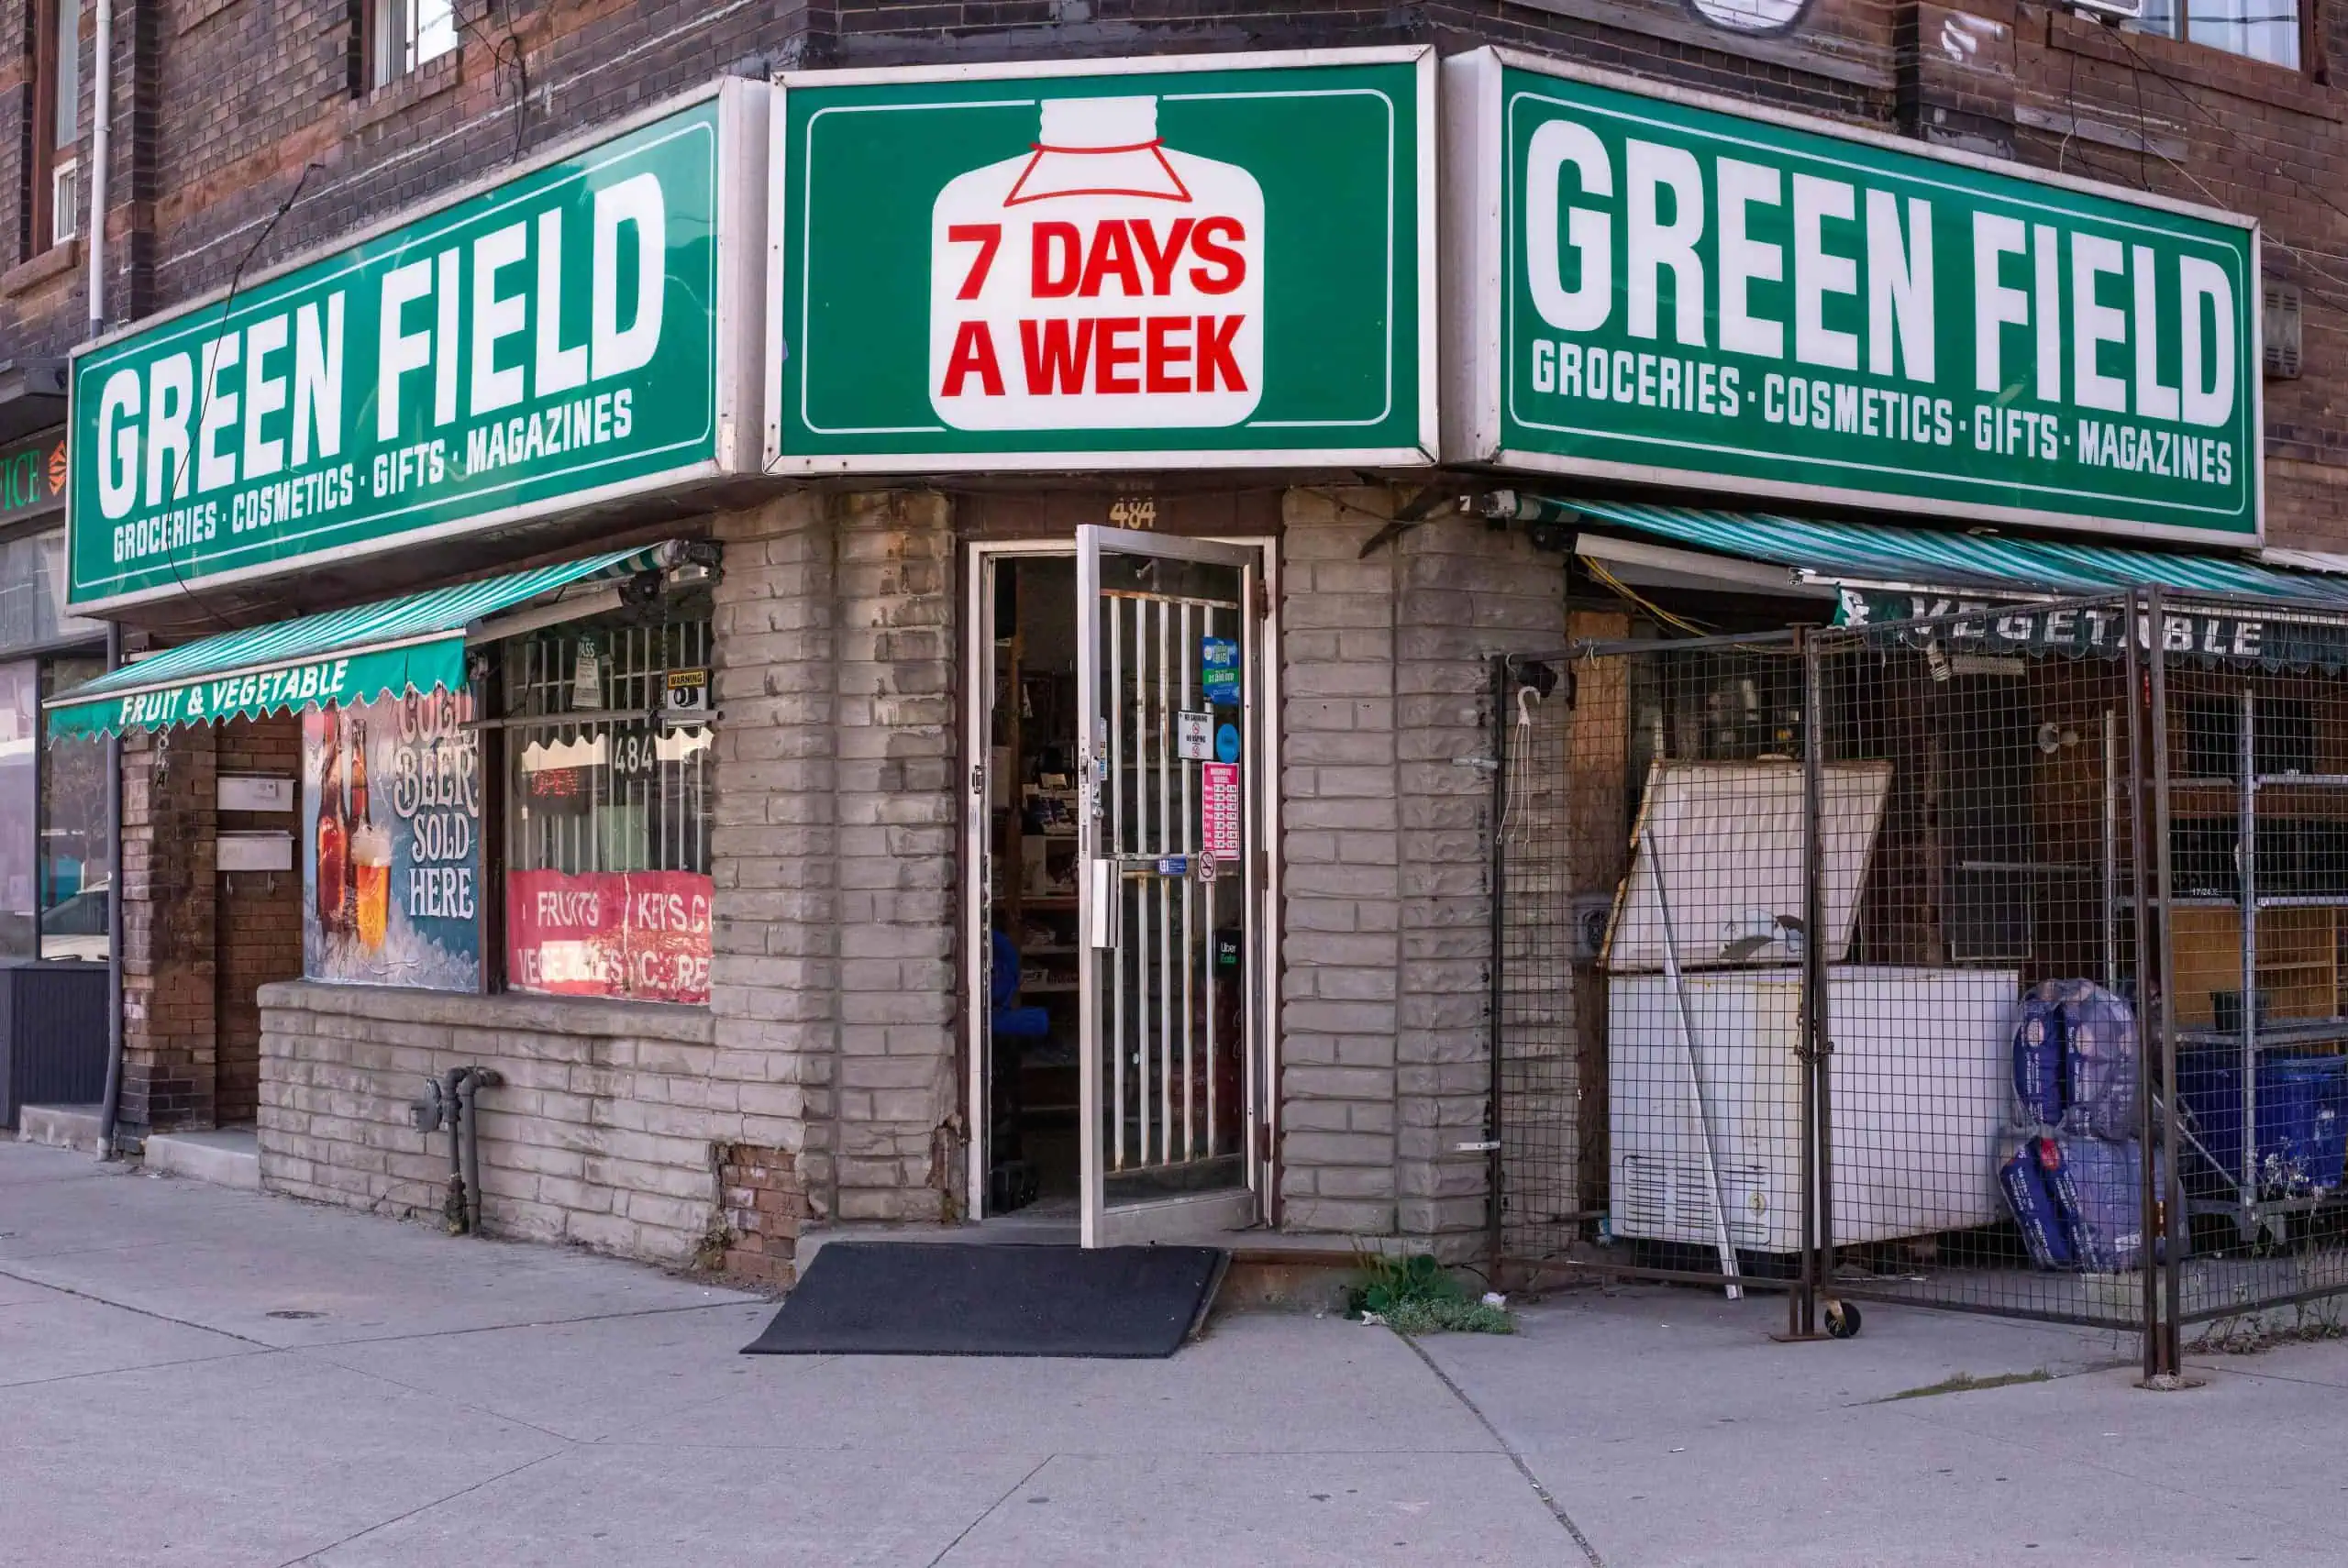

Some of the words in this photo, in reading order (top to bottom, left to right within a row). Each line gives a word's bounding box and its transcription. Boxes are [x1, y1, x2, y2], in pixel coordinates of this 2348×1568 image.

[947, 224, 1002, 301] 7
[1031, 215, 1246, 299] DAYS
[1526, 118, 1935, 384] GREEN
[1973, 210, 2235, 428] FIELD
[97, 289, 346, 520] GREEN
[377, 171, 667, 442] FIELD
[941, 320, 1005, 398] A
[1019, 314, 1249, 397] WEEK
[1532, 338, 1739, 418] GROCERIES
[1764, 372, 1953, 447] COSMETICS
[1975, 404, 2058, 460] GIFTS
[2078, 418, 2232, 485] MAGAZINES
[114, 501, 217, 563] GROCERIES
[232, 462, 353, 535] COSMETICS
[373, 438, 445, 498] GIFTS
[466, 388, 632, 477] MAGAZINES
[1109, 502, 1156, 529] 484
[119, 689, 183, 725] FRUIT
[187, 686, 204, 715] &
[212, 659, 349, 712] VEGETABLE
[670, 672, 704, 686] WARNING
[393, 744, 479, 819] BEER
[615, 734, 654, 775] 484
[413, 812, 471, 864] SOLD
[409, 867, 475, 920] HERE
[537, 890, 599, 927] FRUITS
[1221, 942, 1236, 954] Uber
